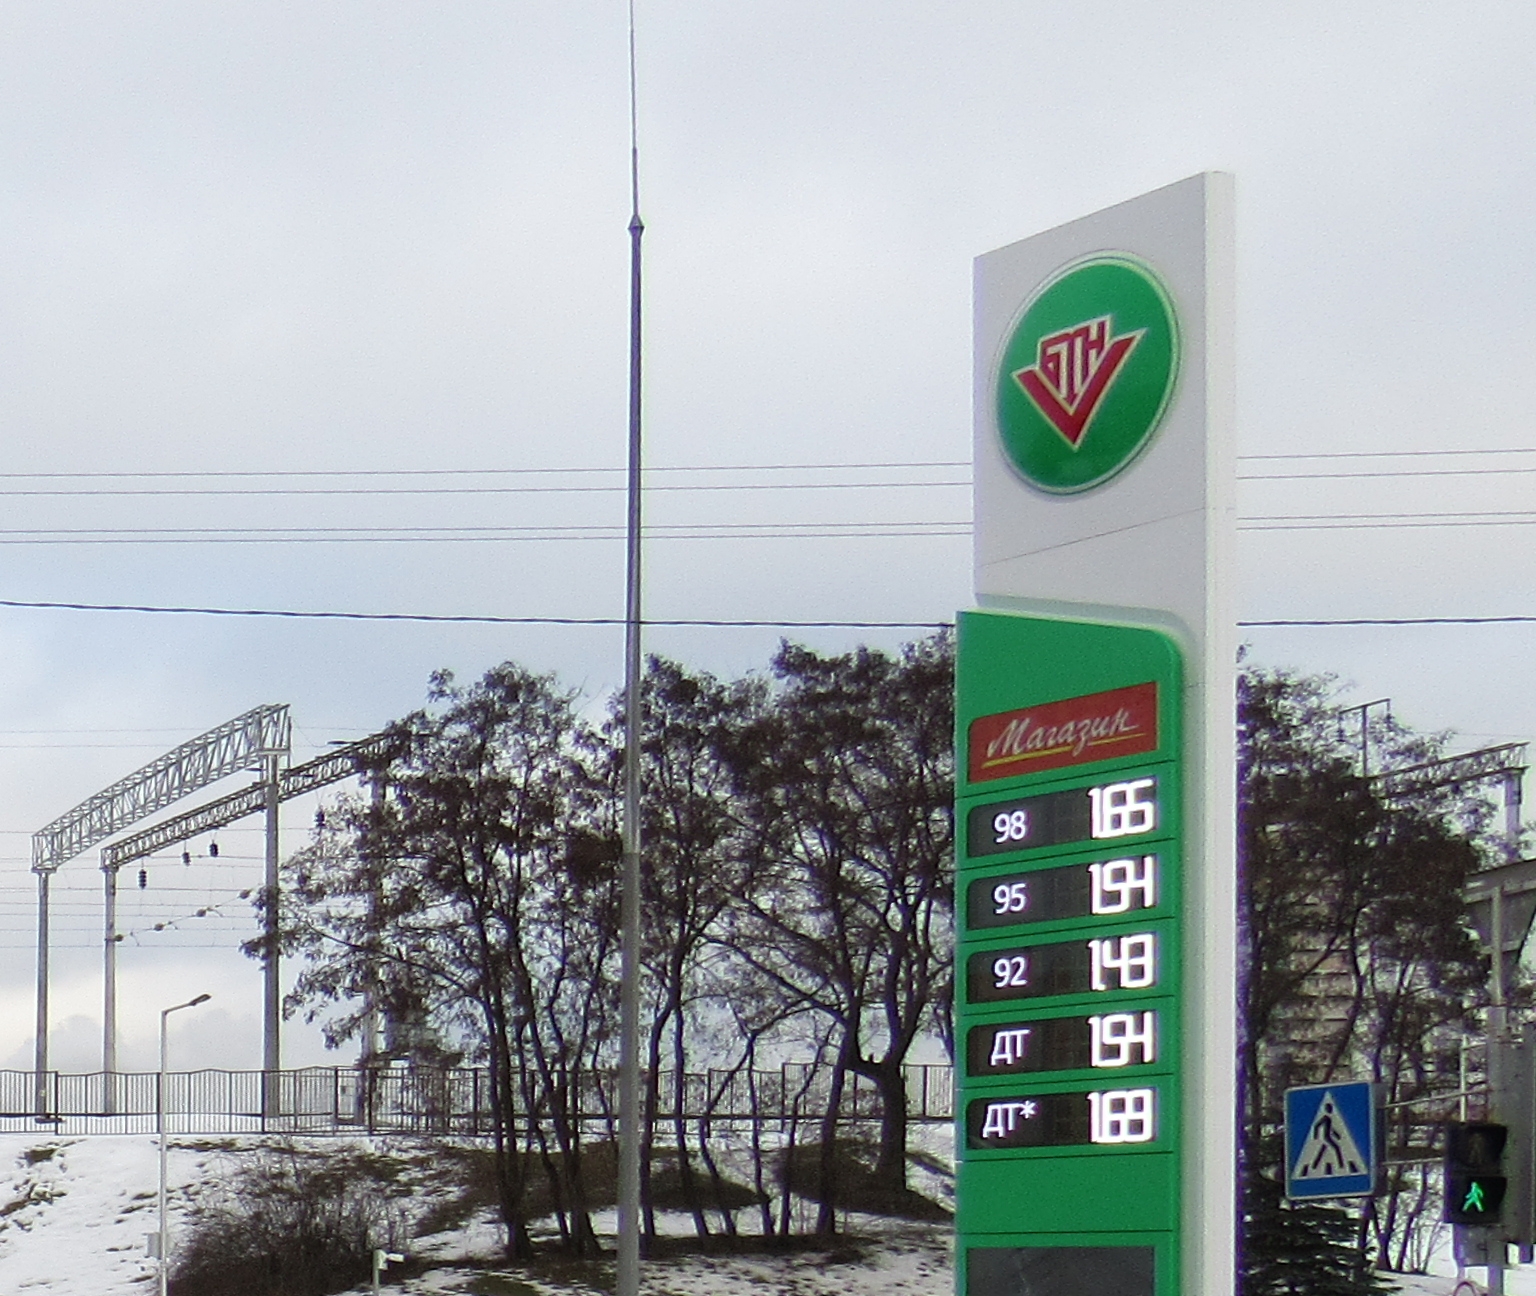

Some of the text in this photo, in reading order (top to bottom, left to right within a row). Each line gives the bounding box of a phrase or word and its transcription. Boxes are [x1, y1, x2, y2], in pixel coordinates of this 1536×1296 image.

[986, 707, 1140, 757] Магазин
[994, 810, 1026, 843] 98
[994, 883, 1026, 914] 95
[994, 956, 1027, 988] 92
[990, 1029, 1031, 1066] ДТ
